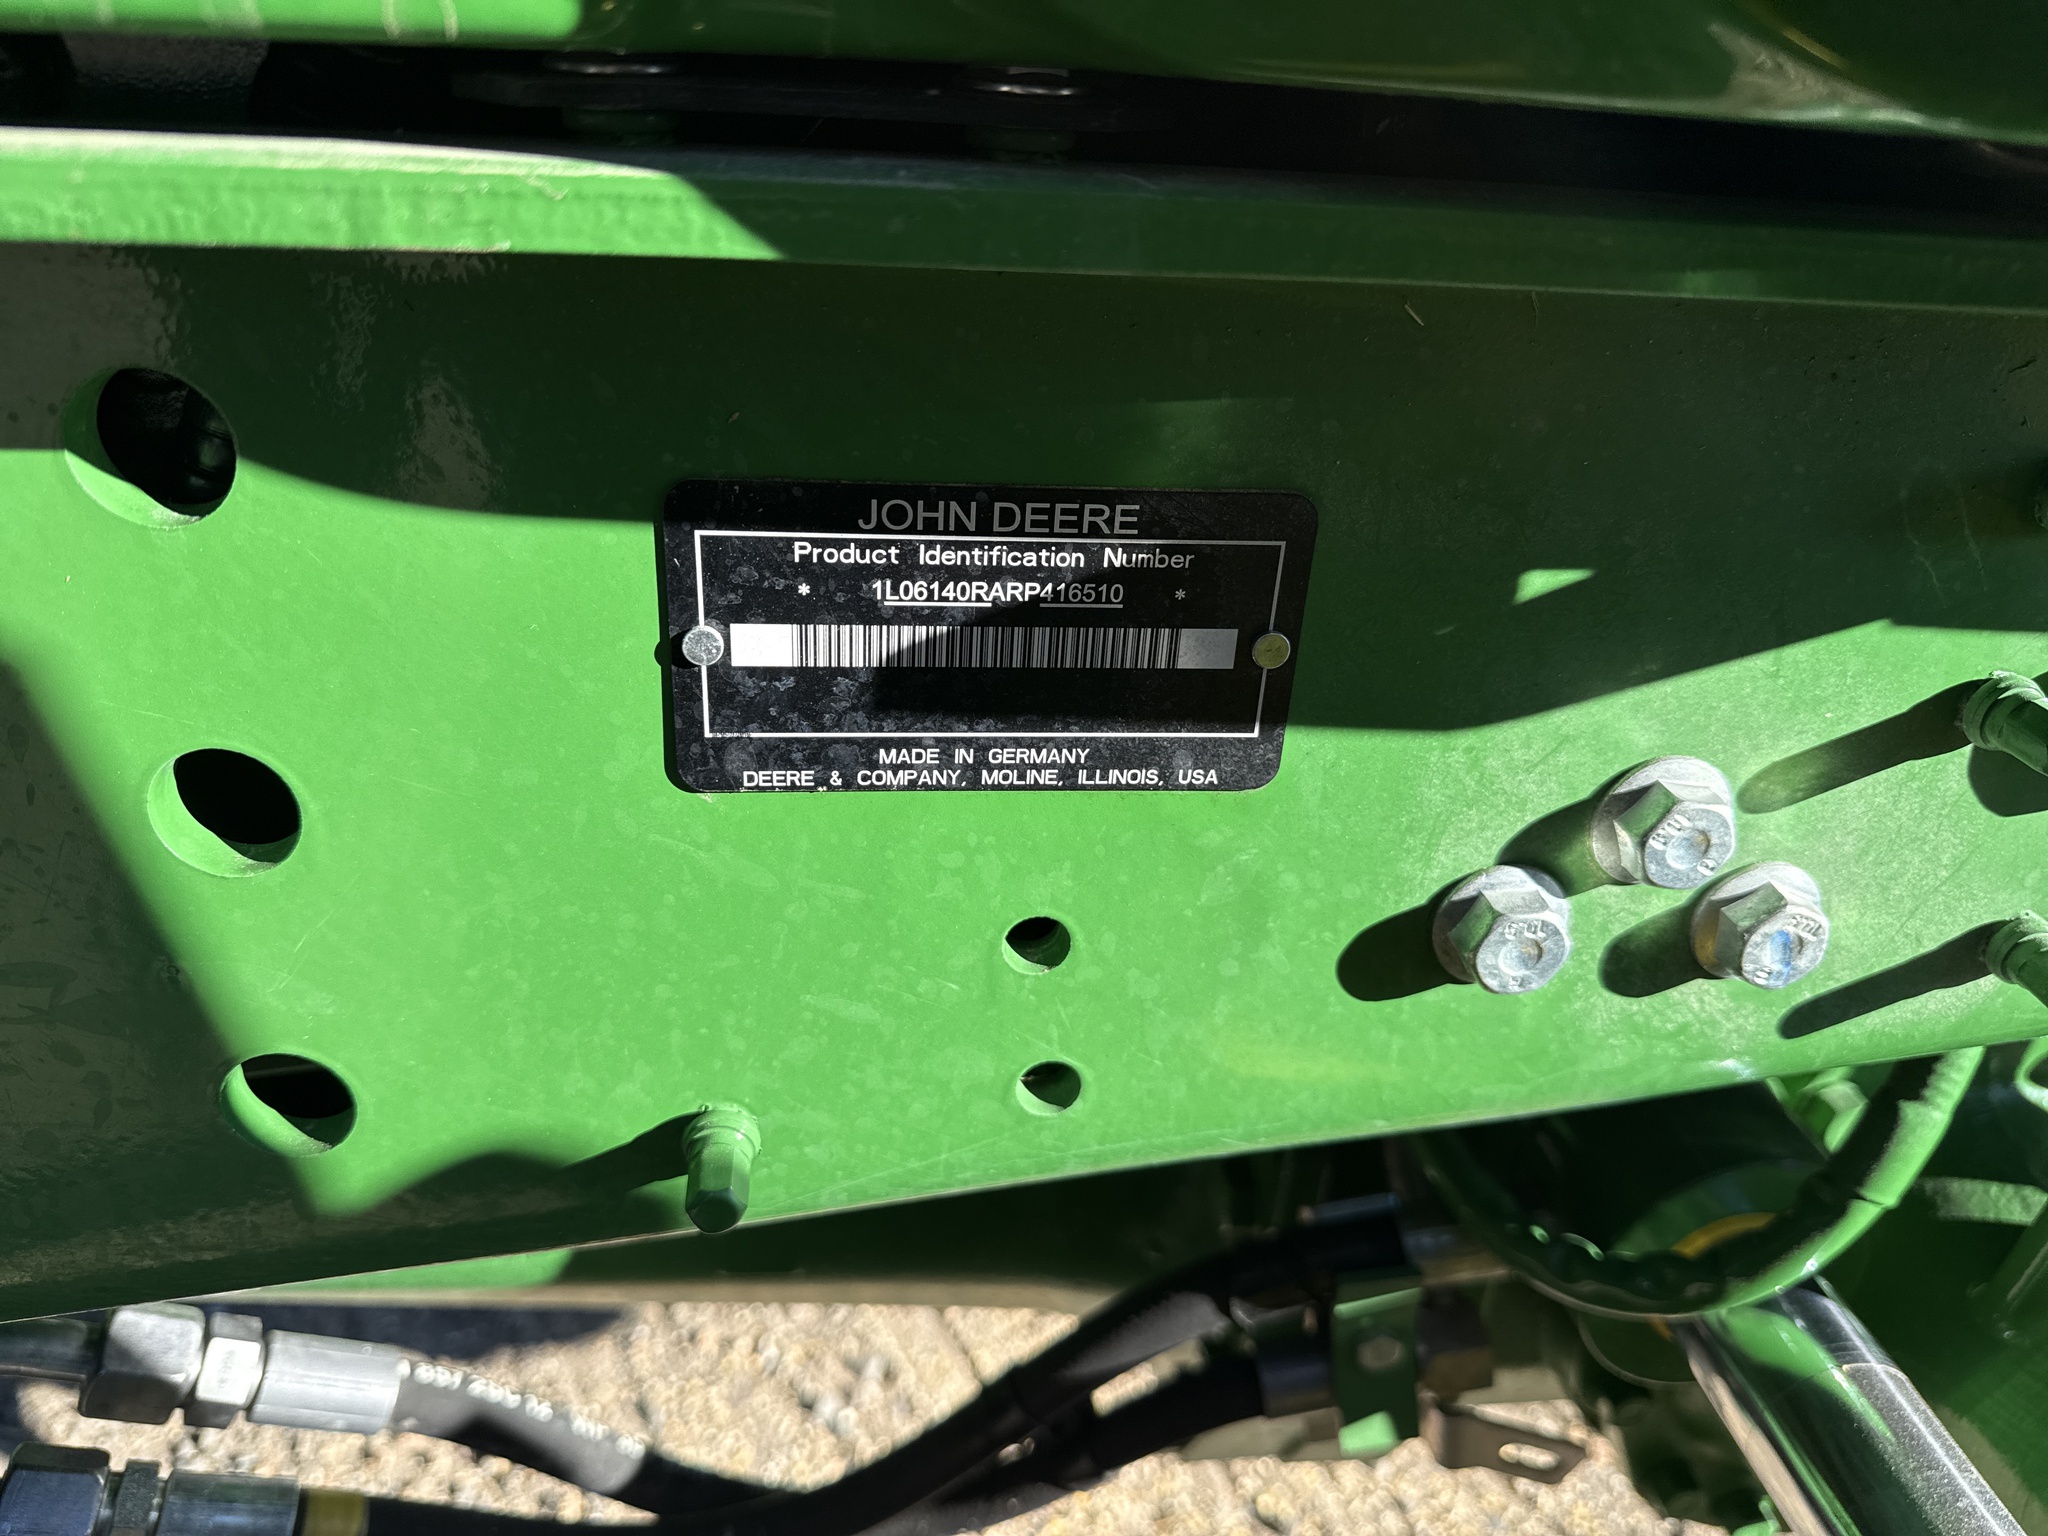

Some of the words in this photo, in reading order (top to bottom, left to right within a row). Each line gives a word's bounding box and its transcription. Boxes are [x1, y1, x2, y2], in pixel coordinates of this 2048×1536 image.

[857, 499, 977, 532] JOHN
[993, 502, 1141, 535] DEERE
[792, 542, 900, 565] Product
[919, 544, 1085, 568] Identification
[1103, 547, 1195, 569] Number
[872, 580, 1124, 604] 1L06140RARP416510
[878, 748, 941, 765] MADE
[954, 748, 974, 765] IN
[988, 747, 1091, 764] GERMANY
[742, 770, 815, 787] DEERE
[829, 770, 843, 786] &
[856, 769, 967, 787] COMPANY,
[981, 769, 1064, 787] MOLINE,
[1077, 768, 1164, 787] ILLINOIS,
[1178, 768, 1219, 785] USA
